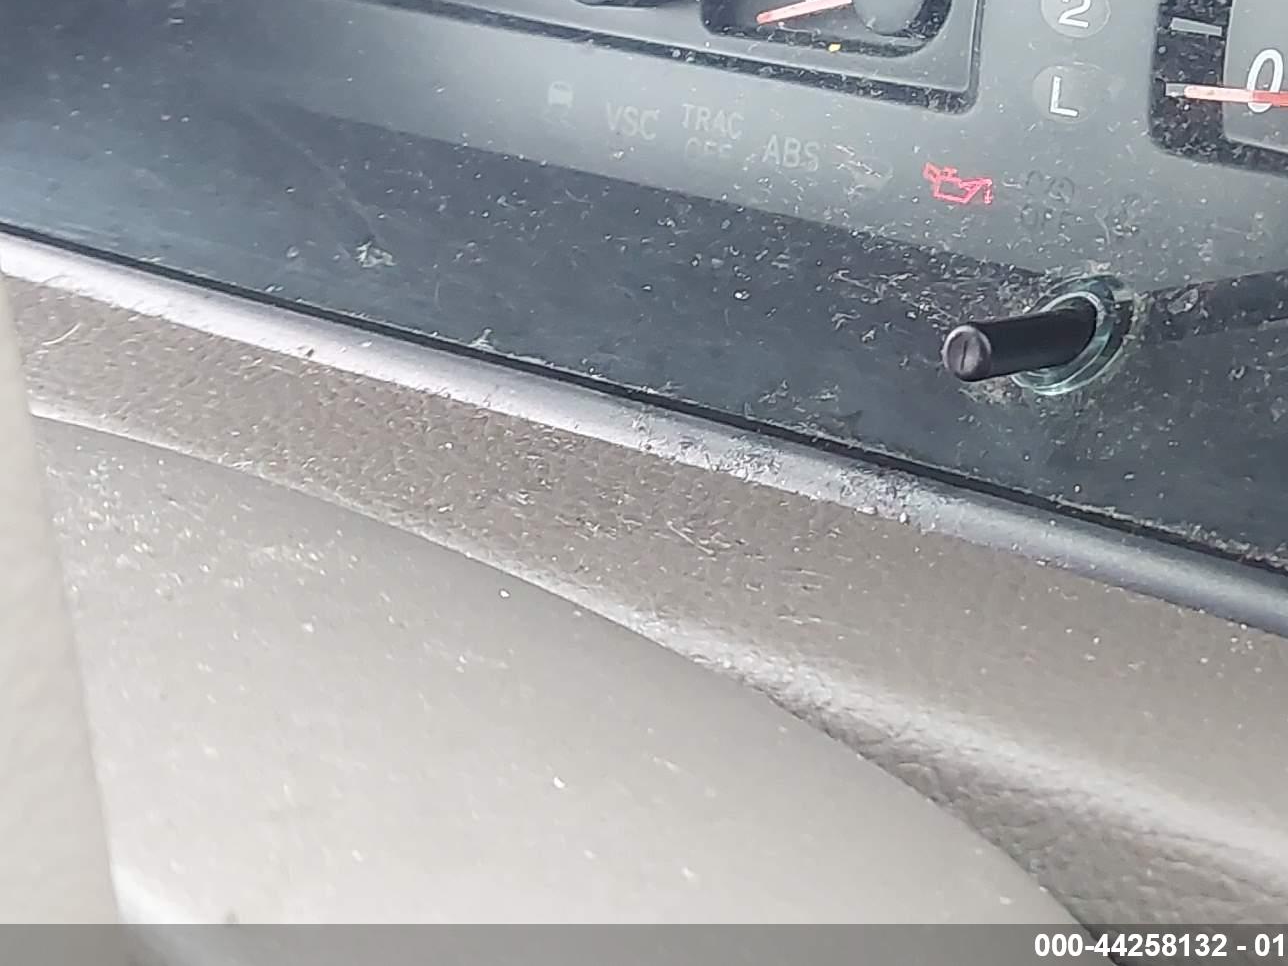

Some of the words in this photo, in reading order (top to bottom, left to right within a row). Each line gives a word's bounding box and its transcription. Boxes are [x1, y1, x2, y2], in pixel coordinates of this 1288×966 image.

[1049, 76, 1079, 118] L
[1246, 48, 1285, 114] 0
[606, 101, 659, 140] VSC
[681, 103, 744, 140] TRAC
[762, 134, 820, 172] ABS
